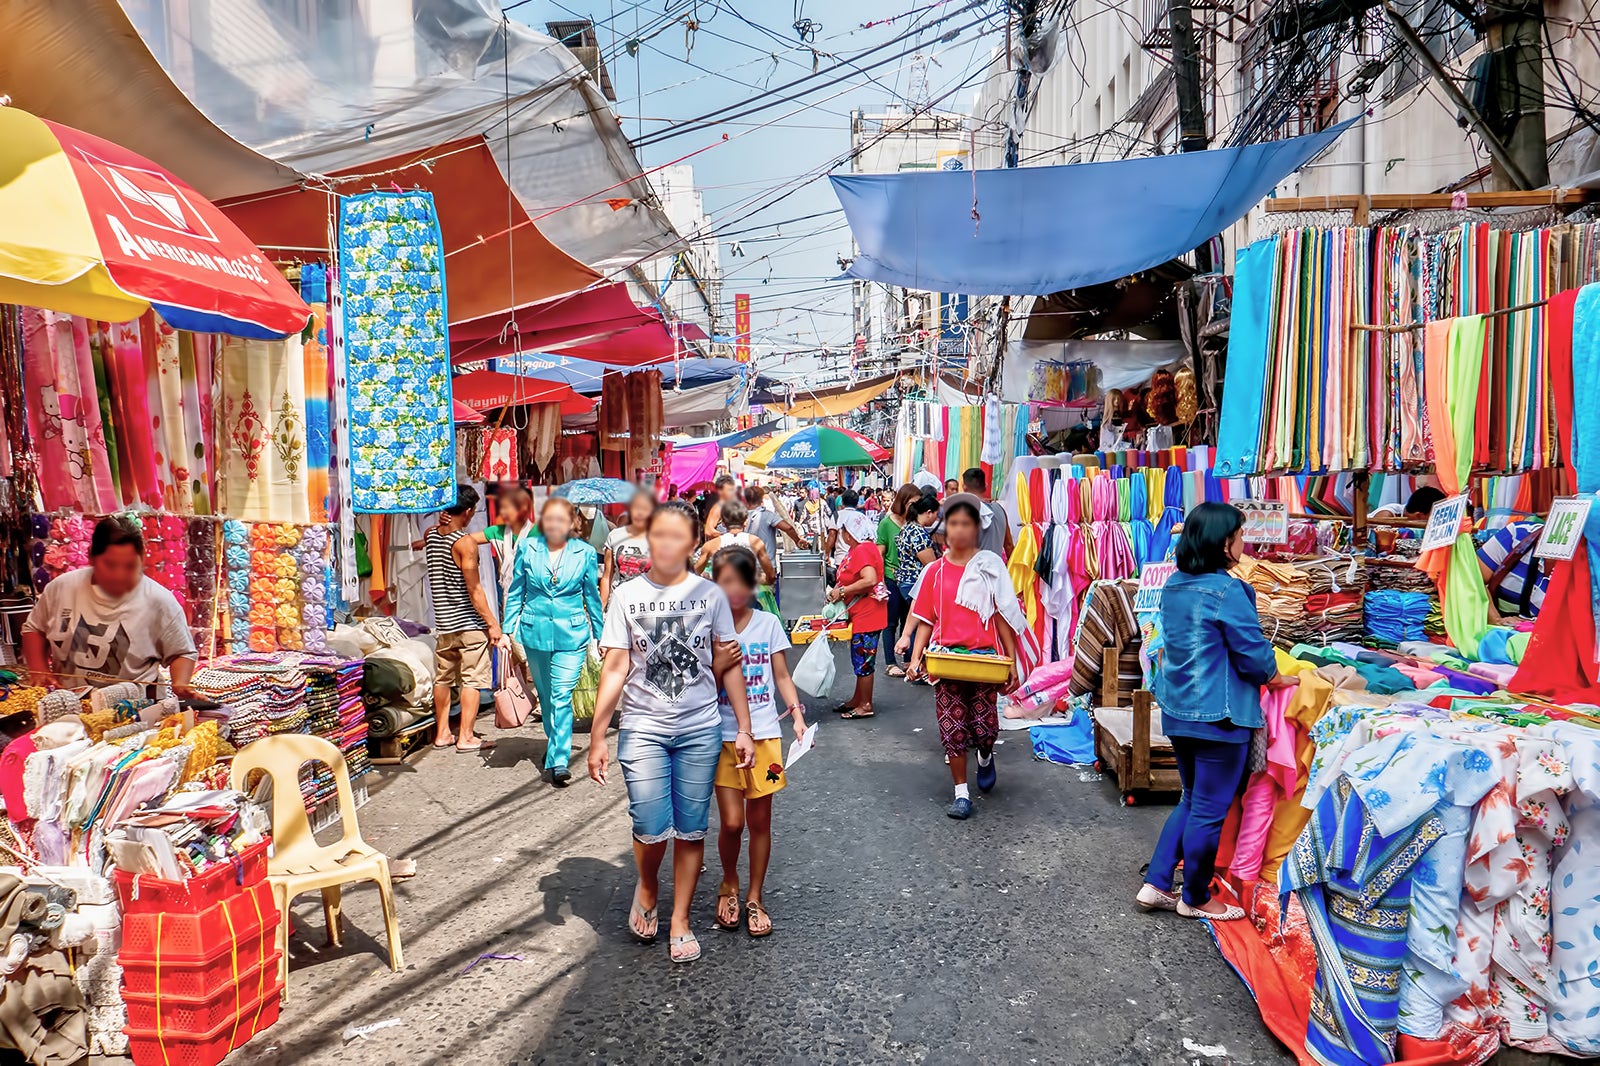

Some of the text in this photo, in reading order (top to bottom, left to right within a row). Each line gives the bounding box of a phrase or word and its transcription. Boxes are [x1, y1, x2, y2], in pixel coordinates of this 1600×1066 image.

[105, 213, 219, 272] AMERICAN
[780, 449, 817, 459] SUNTEX
[1233, 502, 1284, 511] SALE
[1432, 502, 1459, 527] GEENA
[1241, 510, 1283, 537] 20
[1429, 523, 1455, 541] PLAIN
[1546, 511, 1578, 545] LACE
[629, 599, 708, 615] BROOKLYN
[635, 635, 706, 653] 19 91
